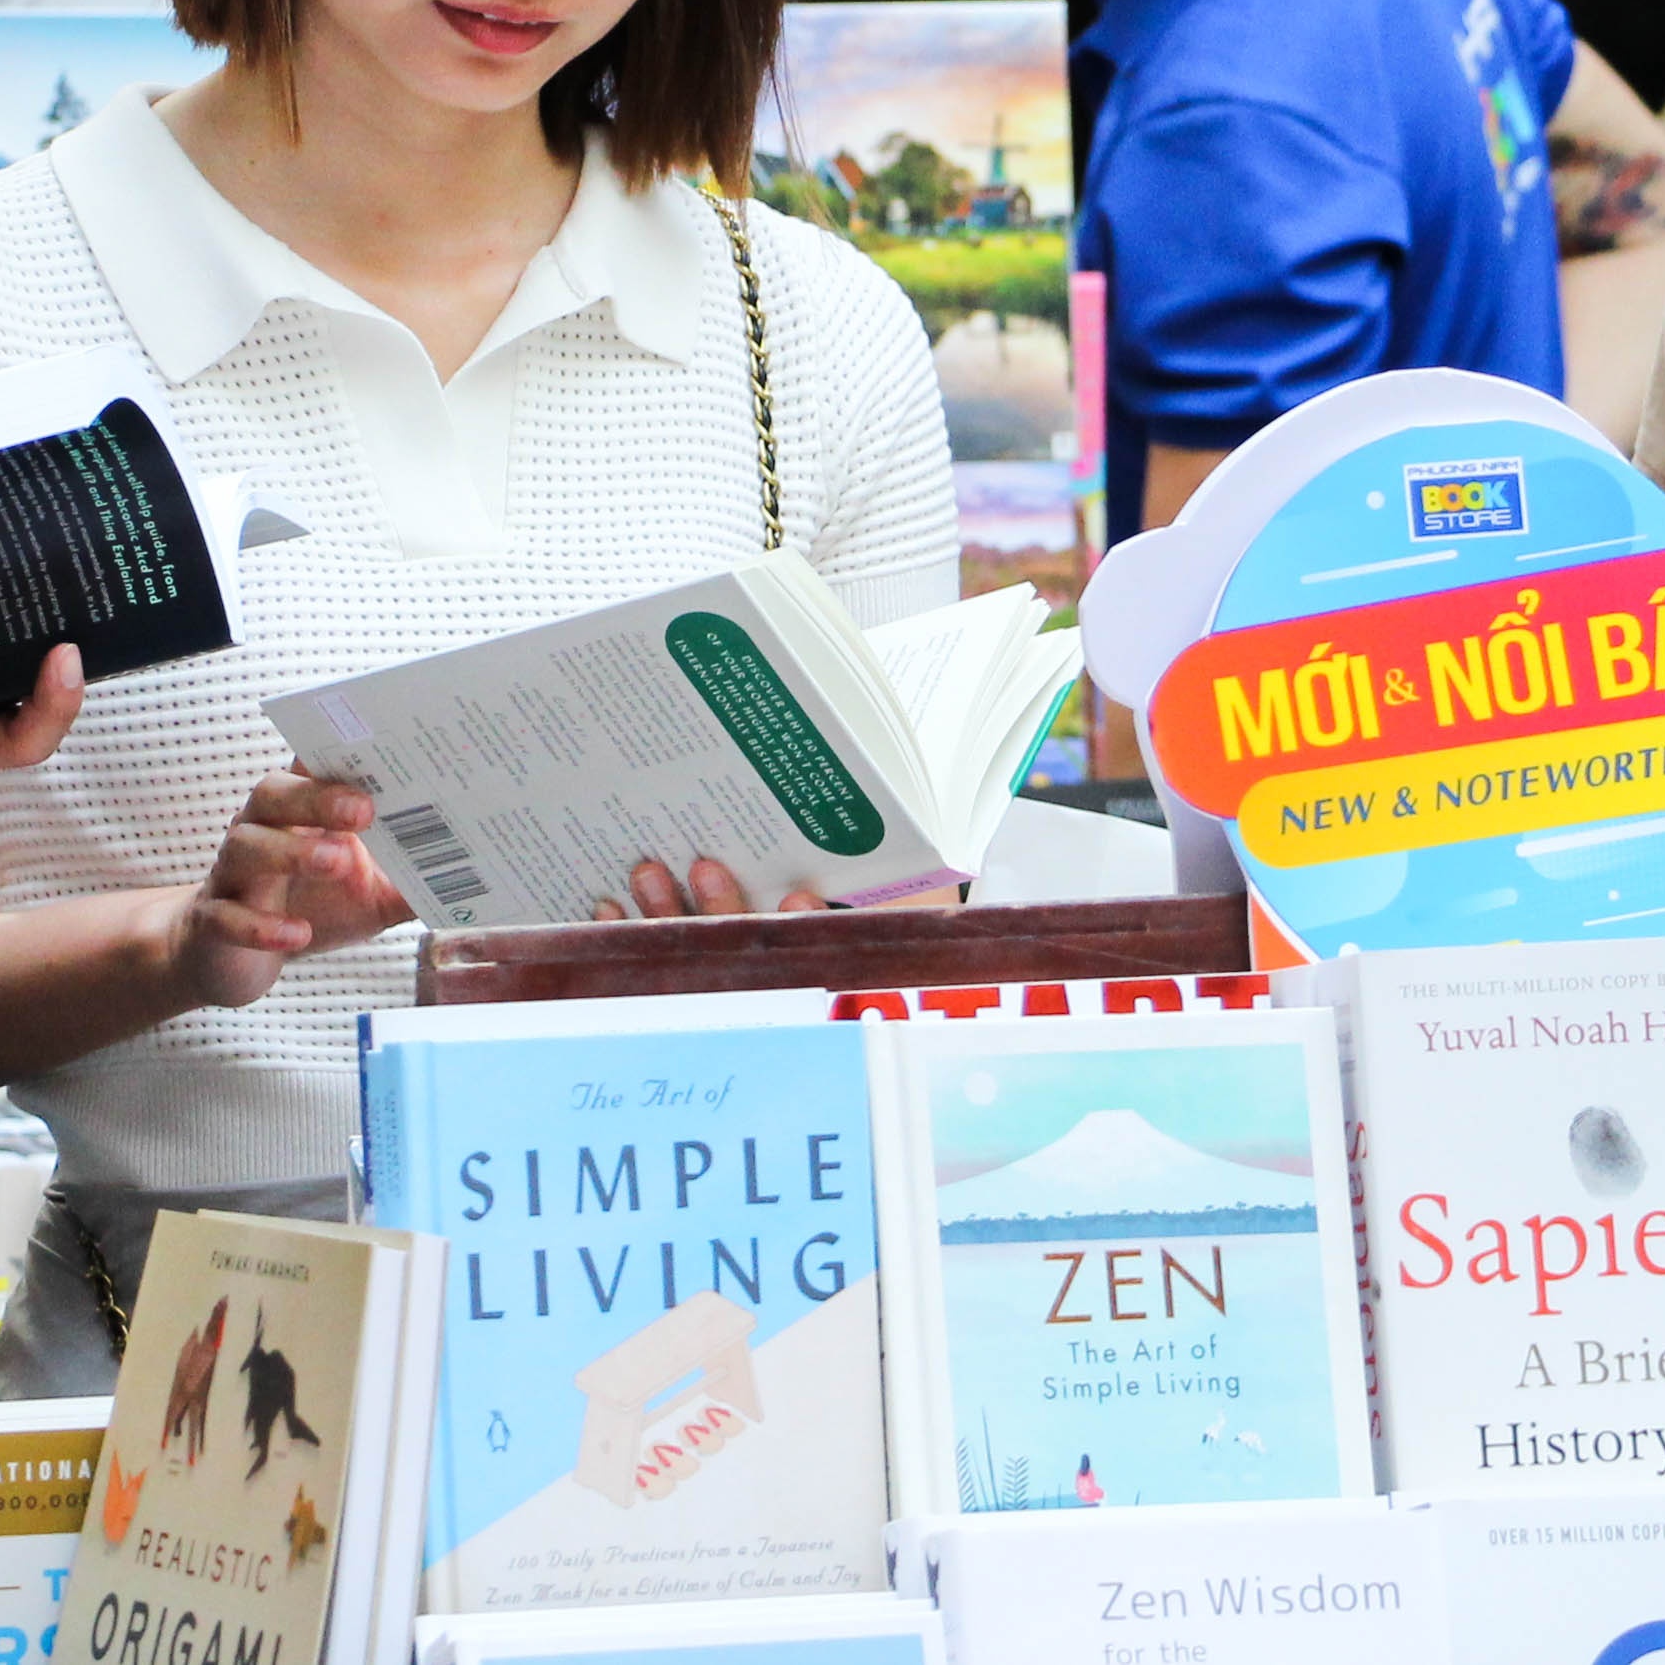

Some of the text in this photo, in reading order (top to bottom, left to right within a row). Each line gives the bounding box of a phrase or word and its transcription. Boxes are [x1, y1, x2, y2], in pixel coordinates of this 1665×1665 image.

[1477, 458, 1520, 476] NAM
[108, 483, 141, 543] webcomic
[1421, 479, 1510, 514] BOOK
[1424, 507, 1513, 530] STORE
[88, 485, 144, 606] and Thing Explainer
[123, 471, 184, 599] self-help guide, from
[132, 543, 154, 574] xkcd
[141, 576, 163, 606] and
[1212, 639, 1377, 762] MỚI
[1383, 668, 1420, 707] &
[1425, 588, 1573, 728] NỔI
[674, 637, 830, 844] INTERNATIONALLY BESTSELLING GUIDE
[705, 630, 723, 649] OF
[719, 648, 747, 681] YOUR
[743, 681, 783, 731] WORRIES
[808, 770, 837, 804] COME
[833, 804, 859, 835] TRUE
[710, 661, 821, 807] IN THIS HIGHLY PRACTICAL
[740, 653, 786, 710] DISCOVER
[781, 709, 805, 736] WHY
[814, 753, 855, 804] PERCENT
[1280, 789, 1376, 836] NEW
[1392, 781, 1420, 818] &
[1399, 983, 1439, 1000] THE
[1446, 976, 1595, 998] MULTI-MILLION
[1601, 974, 1650, 991] COPY
[1418, 1016, 1517, 1054] Yuval
[1531, 1013, 1628, 1048] Noah
[571, 1074, 735, 1111] The Art of
[459, 1133, 844, 1221] SIMPLE
[467, 1232, 845, 1320] LIVING
[1043, 1245, 1227, 1323] ZEN
[1067, 1334, 1218, 1364] The Art of
[1516, 1343, 1552, 1390] A
[1043, 1370, 1240, 1403] Simple Living
[548, 1549, 596, 1572] Daily
[604, 1545, 684, 1566] Practices
[688, 1542, 732, 1567] from
[753, 1538, 834, 1561] Japanese
[1488, 1529, 1530, 1546] OVER
[1537, 1526, 1554, 1544] 15
[1562, 1523, 1626, 1544] MILLION
[136, 1528, 273, 1593] REALISTIC
[1099, 1575, 1401, 1621] Zen Wisdom
[91, 1592, 283, 1665] ORIGAMI
